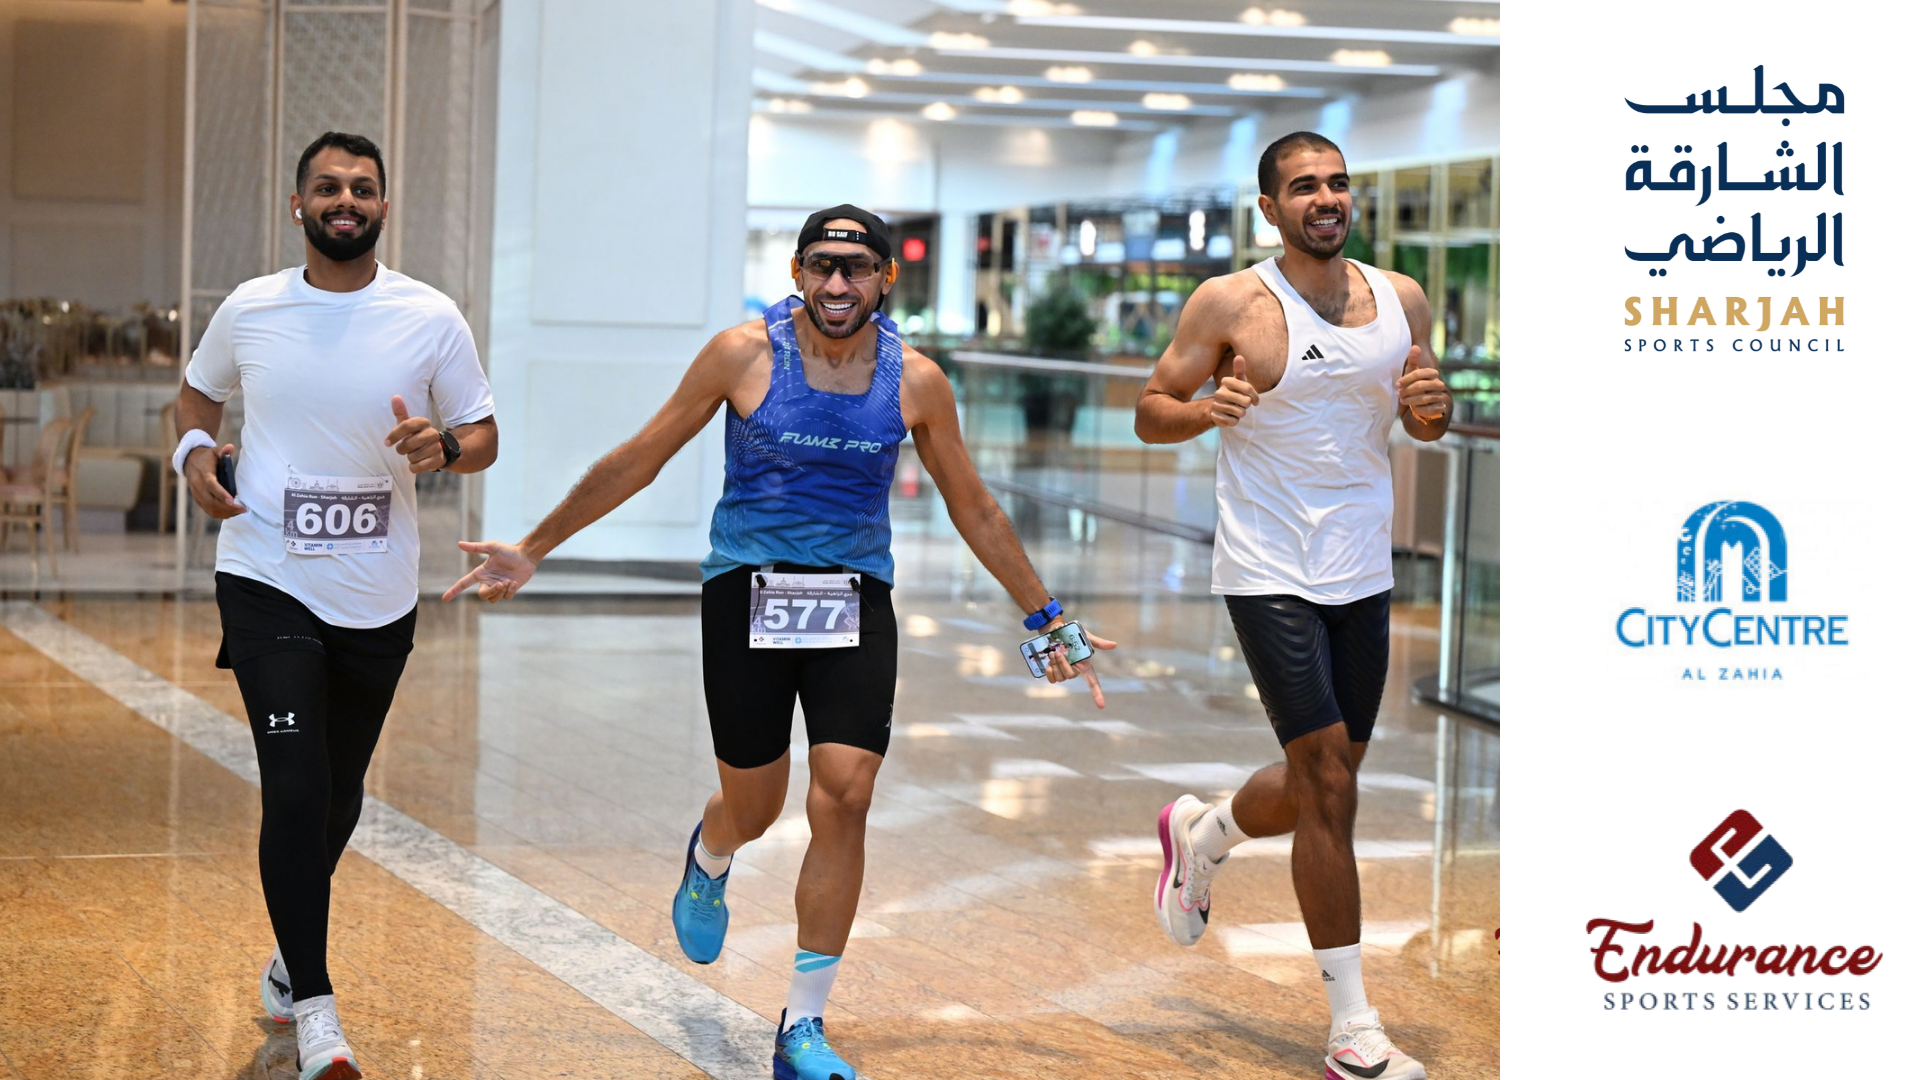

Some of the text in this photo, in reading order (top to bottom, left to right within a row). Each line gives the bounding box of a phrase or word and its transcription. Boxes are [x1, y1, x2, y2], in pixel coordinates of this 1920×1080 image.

[843, 440, 882, 453] PRO
[296, 502, 377, 536] 606
[763, 599, 846, 630] 577
